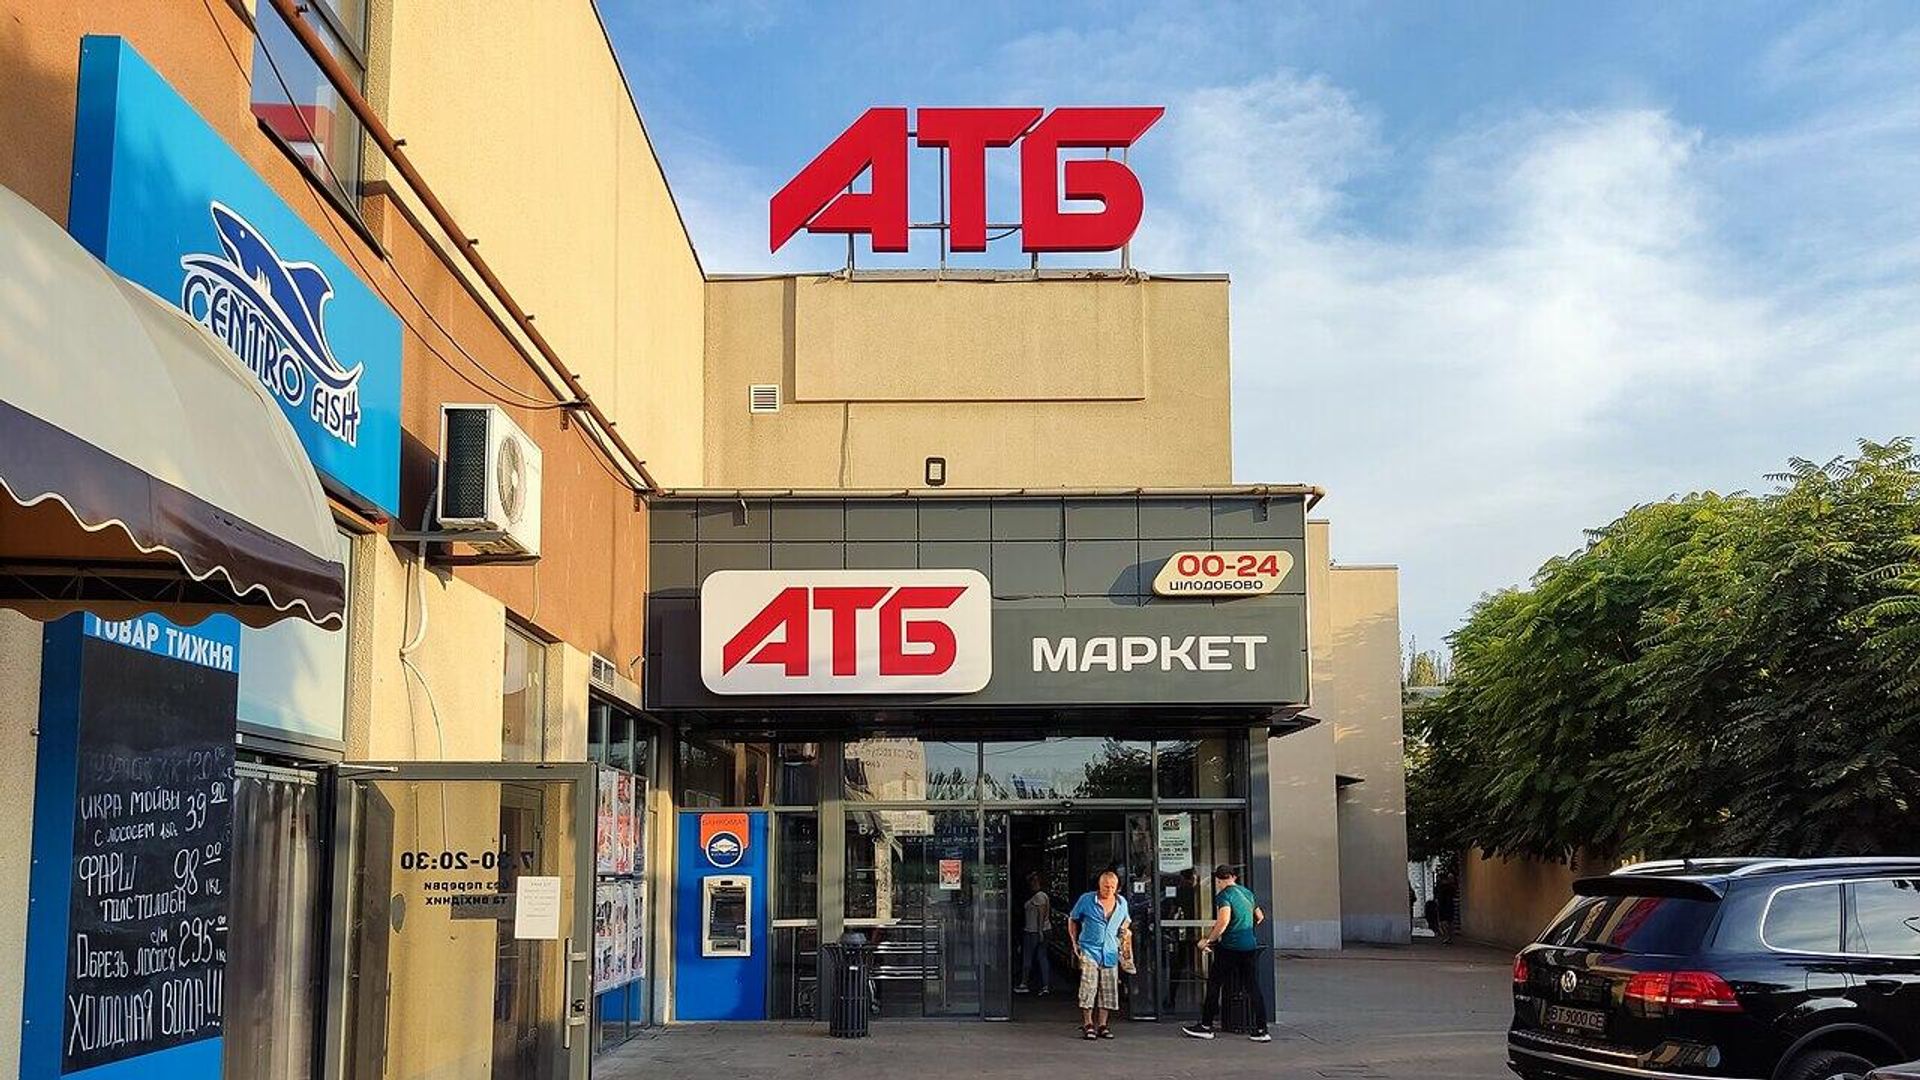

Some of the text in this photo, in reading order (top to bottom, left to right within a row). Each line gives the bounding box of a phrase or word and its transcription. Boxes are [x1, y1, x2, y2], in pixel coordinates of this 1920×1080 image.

[770, 107, 1165, 254] АТБ
[183, 270, 361, 447] CENTRO FISH
[1169, 580, 1264, 591] ЦІЛОДОБОВО
[1177, 555, 1280, 577] 00-24
[166, 627, 234, 671] ТИЖНЯ
[722, 586, 968, 677] АТБ
[1032, 635, 1267, 673] МАРКЕТ
[80, 786, 180, 820] ИКРА МОЙВЫ
[185, 789, 207, 832] 39
[79, 852, 137, 896] ФАРШ
[174, 848, 200, 895] 98
[179, 917, 215, 967] 295
[68, 988, 153, 1056] ХОЛОДНАЯ
